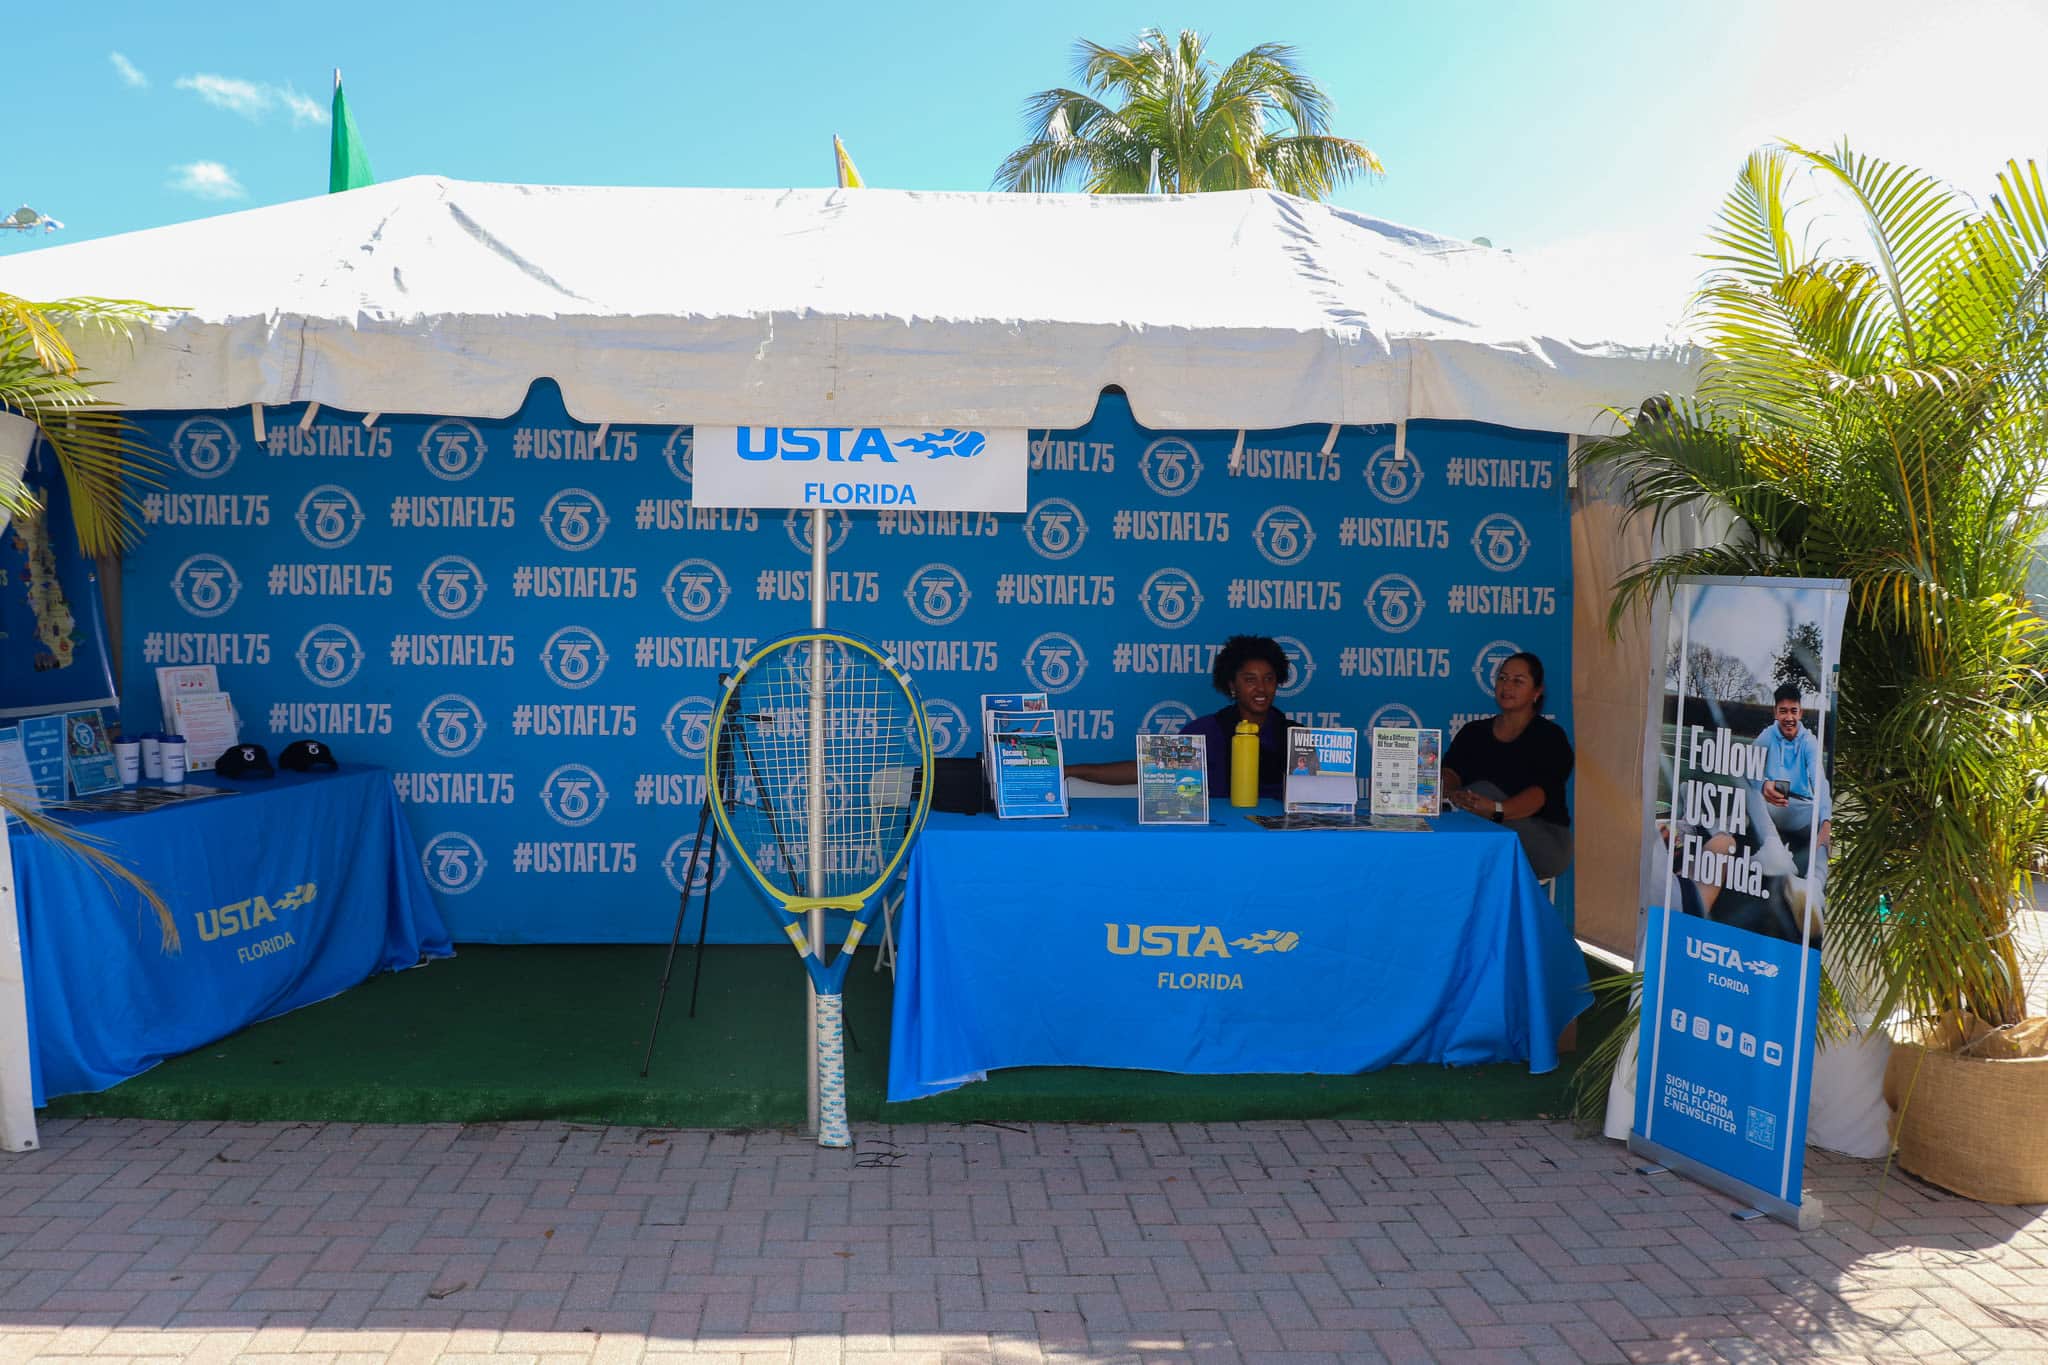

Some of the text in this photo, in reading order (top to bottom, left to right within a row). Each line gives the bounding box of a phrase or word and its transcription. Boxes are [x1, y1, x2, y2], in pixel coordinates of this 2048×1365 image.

[267, 425, 392, 457] #USTAFL75
[513, 428, 638, 461] #USTAFL75
[737, 426, 898, 462] USTA
[1027, 440, 1115, 472] STAFL75
[1228, 449, 1341, 481] #USTAFL75
[1447, 457, 1552, 489] #USTAFL75
[143, 493, 270, 526] #USTAFL75
[805, 483, 916, 504] FLORIDA
[391, 496, 515, 528] #USTAFL75
[636, 499, 758, 531] #USTAFL75
[877, 509, 998, 536] #USTAFL75
[1113, 510, 1229, 542] #USTAFL75
[1340, 517, 1449, 549] #USTAFL75
[267, 564, 393, 596] #USTAFL75
[513, 566, 637, 599] #USTAFL75
[757, 569, 879, 602] #USTFL75
[996, 574, 1115, 606] #USTAFL75
[1228, 579, 1341, 611] #USTAFL75
[1448, 584, 1555, 615] #USTAFL75
[143, 633, 270, 665] #USTAFL75
[391, 634, 515, 666] #USTAFL75
[1112, 643, 1226, 674] #USTAFL7
[1340, 647, 1450, 677] #USTAFL75
[269, 703, 392, 734] #USTAFL75
[513, 704, 637, 736] #USTAFL75
[1294, 732, 1352, 749] WHEELCHAIR
[1319, 749, 1352, 764] TENNIS
[1689, 724, 1768, 781] Follow
[393, 772, 515, 804] #USTAFL75
[1686, 779, 1747, 836] USTA
[513, 842, 637, 873] #USTAFL75
[1681, 833, 1770, 899] Florida.
[195, 896, 277, 941] USTA
[238, 932, 296, 964] FLORIDA
[1104, 923, 1232, 958] USTA
[1686, 936, 1744, 972] USTA
[1158, 972, 1243, 990] FLORIDA
[1707, 973, 1750, 995] FLORIDA
[1664, 1085, 1734, 1122] USTA FLORIDA
[1665, 1074, 1728, 1107] SIGN UP FOR
[1663, 1095, 1737, 1135] E-NEWSLETTER
